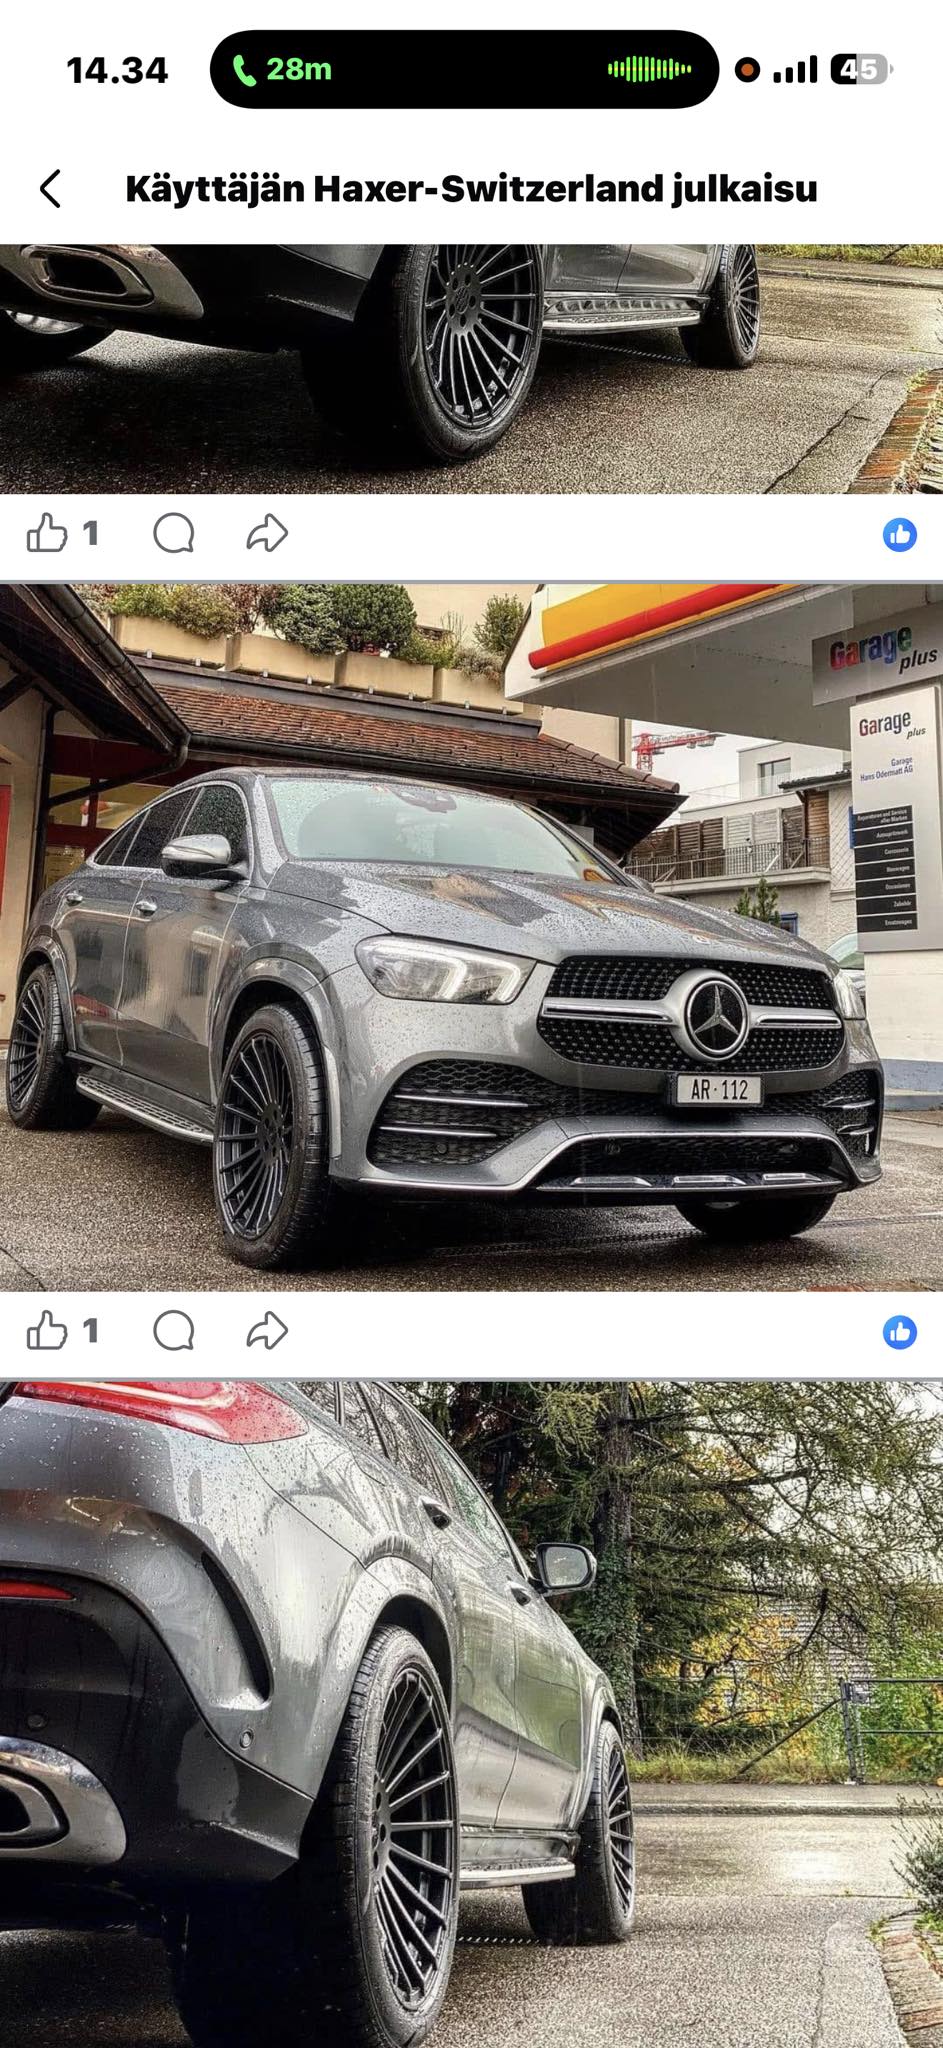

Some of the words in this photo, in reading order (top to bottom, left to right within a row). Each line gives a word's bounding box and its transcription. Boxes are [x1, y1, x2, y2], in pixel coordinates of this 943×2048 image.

[67, 56, 169, 85] 14.34
[266, 57, 332, 81] 28m
[840, 58, 877, 80] 45
[126, 171, 305, 210] Käyttäjän
[314, 171, 664, 203] Haxer-Switzerland
[670, 171, 817, 209] julkaisu
[83, 520, 98, 546] 1
[830, 627, 912, 671] Garage
[899, 648, 939, 675] plus
[859, 712, 912, 737] Garage
[906, 727, 927, 740] plus
[891, 757, 913, 767] Garage
[904, 764, 914, 774] AG
[83, 1317, 98, 1343] 1
